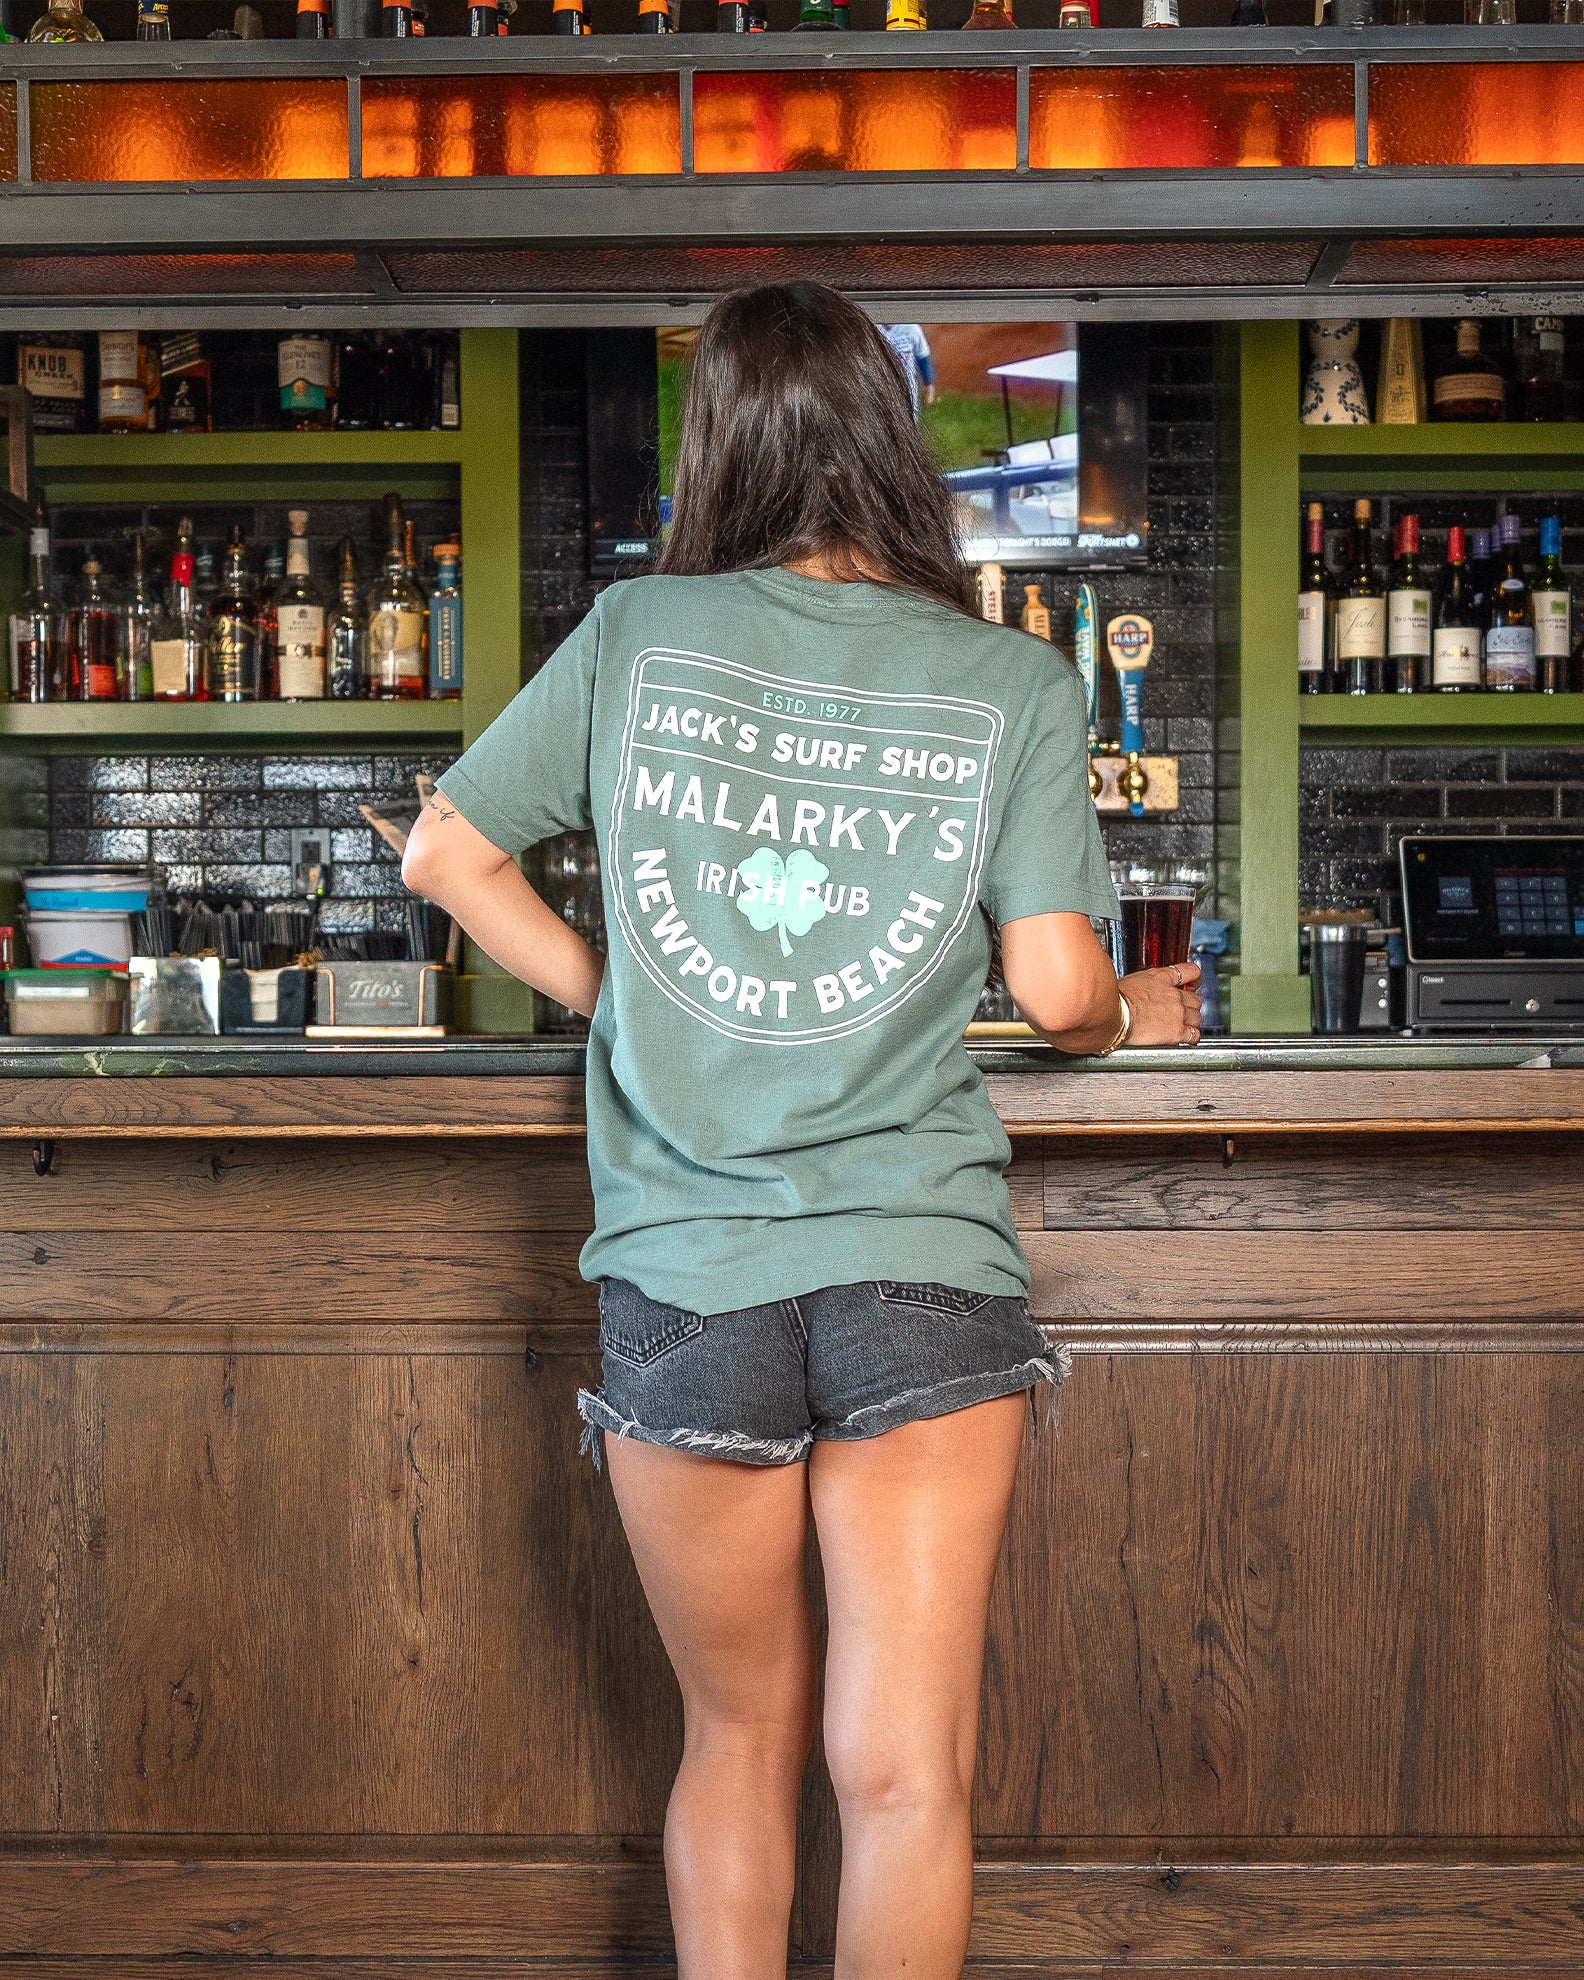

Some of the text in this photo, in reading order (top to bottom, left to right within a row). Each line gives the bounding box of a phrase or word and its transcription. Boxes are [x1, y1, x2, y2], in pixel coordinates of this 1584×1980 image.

[27, 354, 67, 372] KNOB
[614, 542, 649, 554] ACCESS
[987, 590, 997, 621] STELL
[1112, 633, 1149, 644] HARP
[762, 691, 861, 722] ESTD. 1977
[1124, 683, 1140, 727] HARP
[642, 703, 978, 785] JACK'S SURF SHOP
[633, 765, 967, 862] MALARKY'S
[696, 860, 870, 917] IRISH PUB
[632, 847, 945, 1019] NEWPORT BEACH
[349, 979, 404, 1000] Tito's
